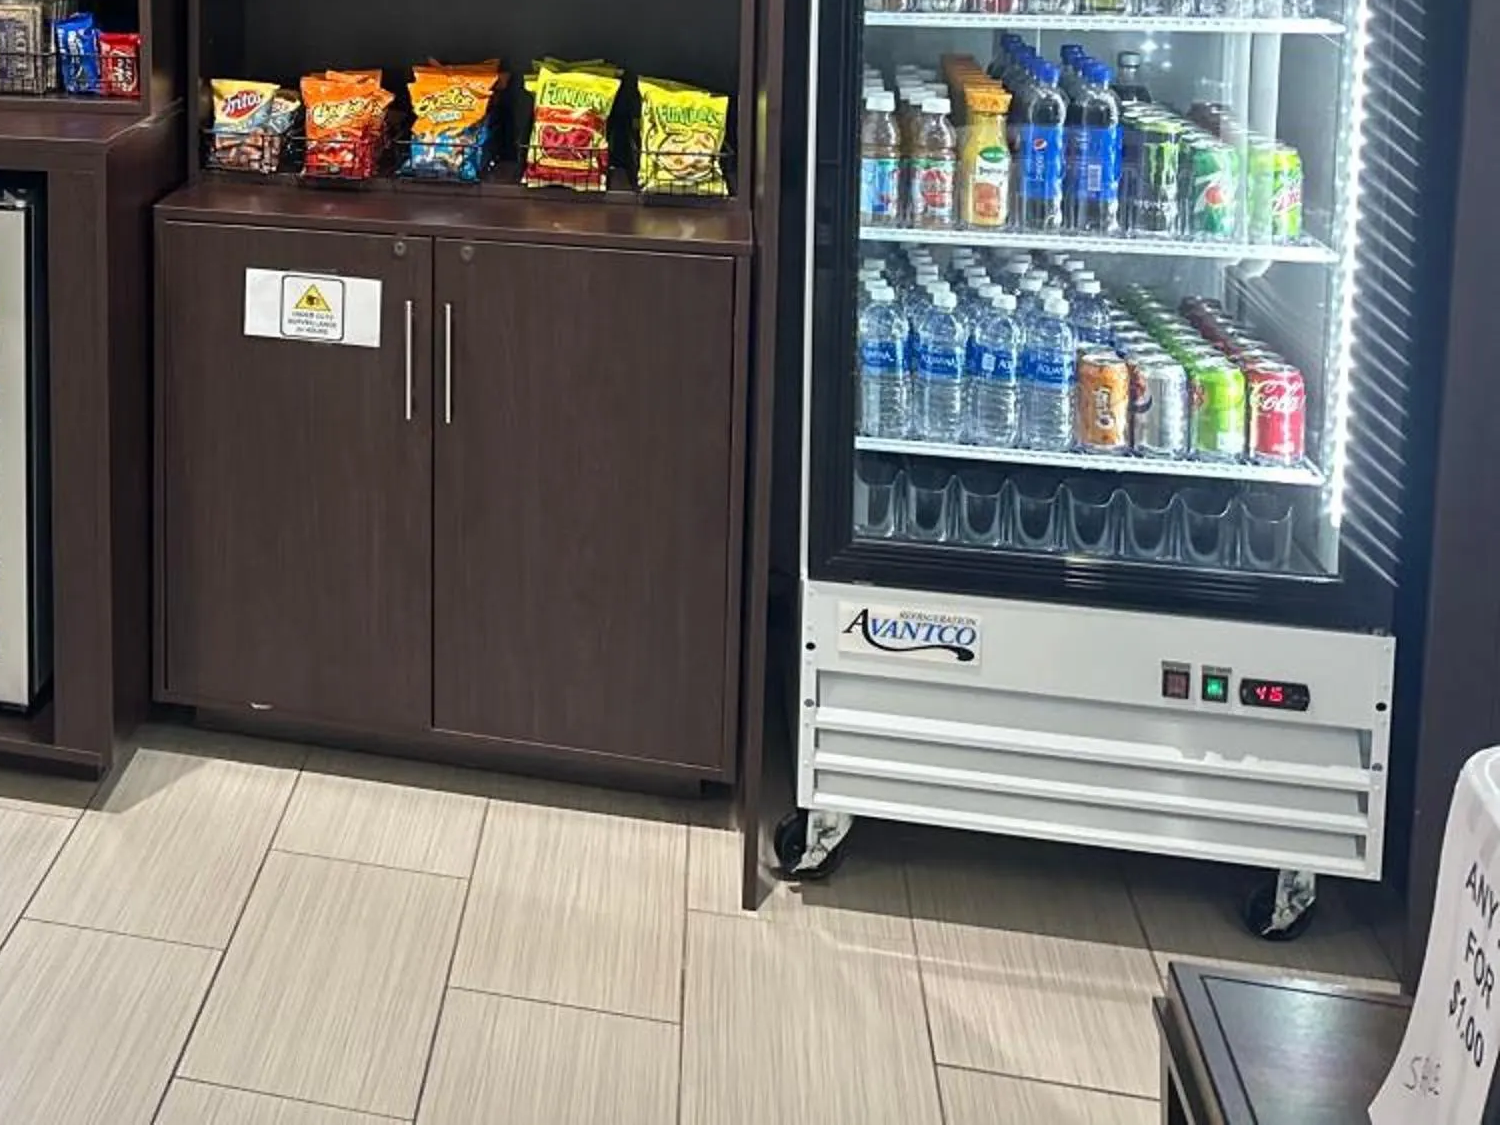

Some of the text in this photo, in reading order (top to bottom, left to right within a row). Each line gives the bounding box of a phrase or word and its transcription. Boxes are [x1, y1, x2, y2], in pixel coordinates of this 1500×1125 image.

[842, 607, 977, 648] AVANTCO
[1465, 861, 1500, 930] ANY
[1465, 931, 1496, 1011] FOR
